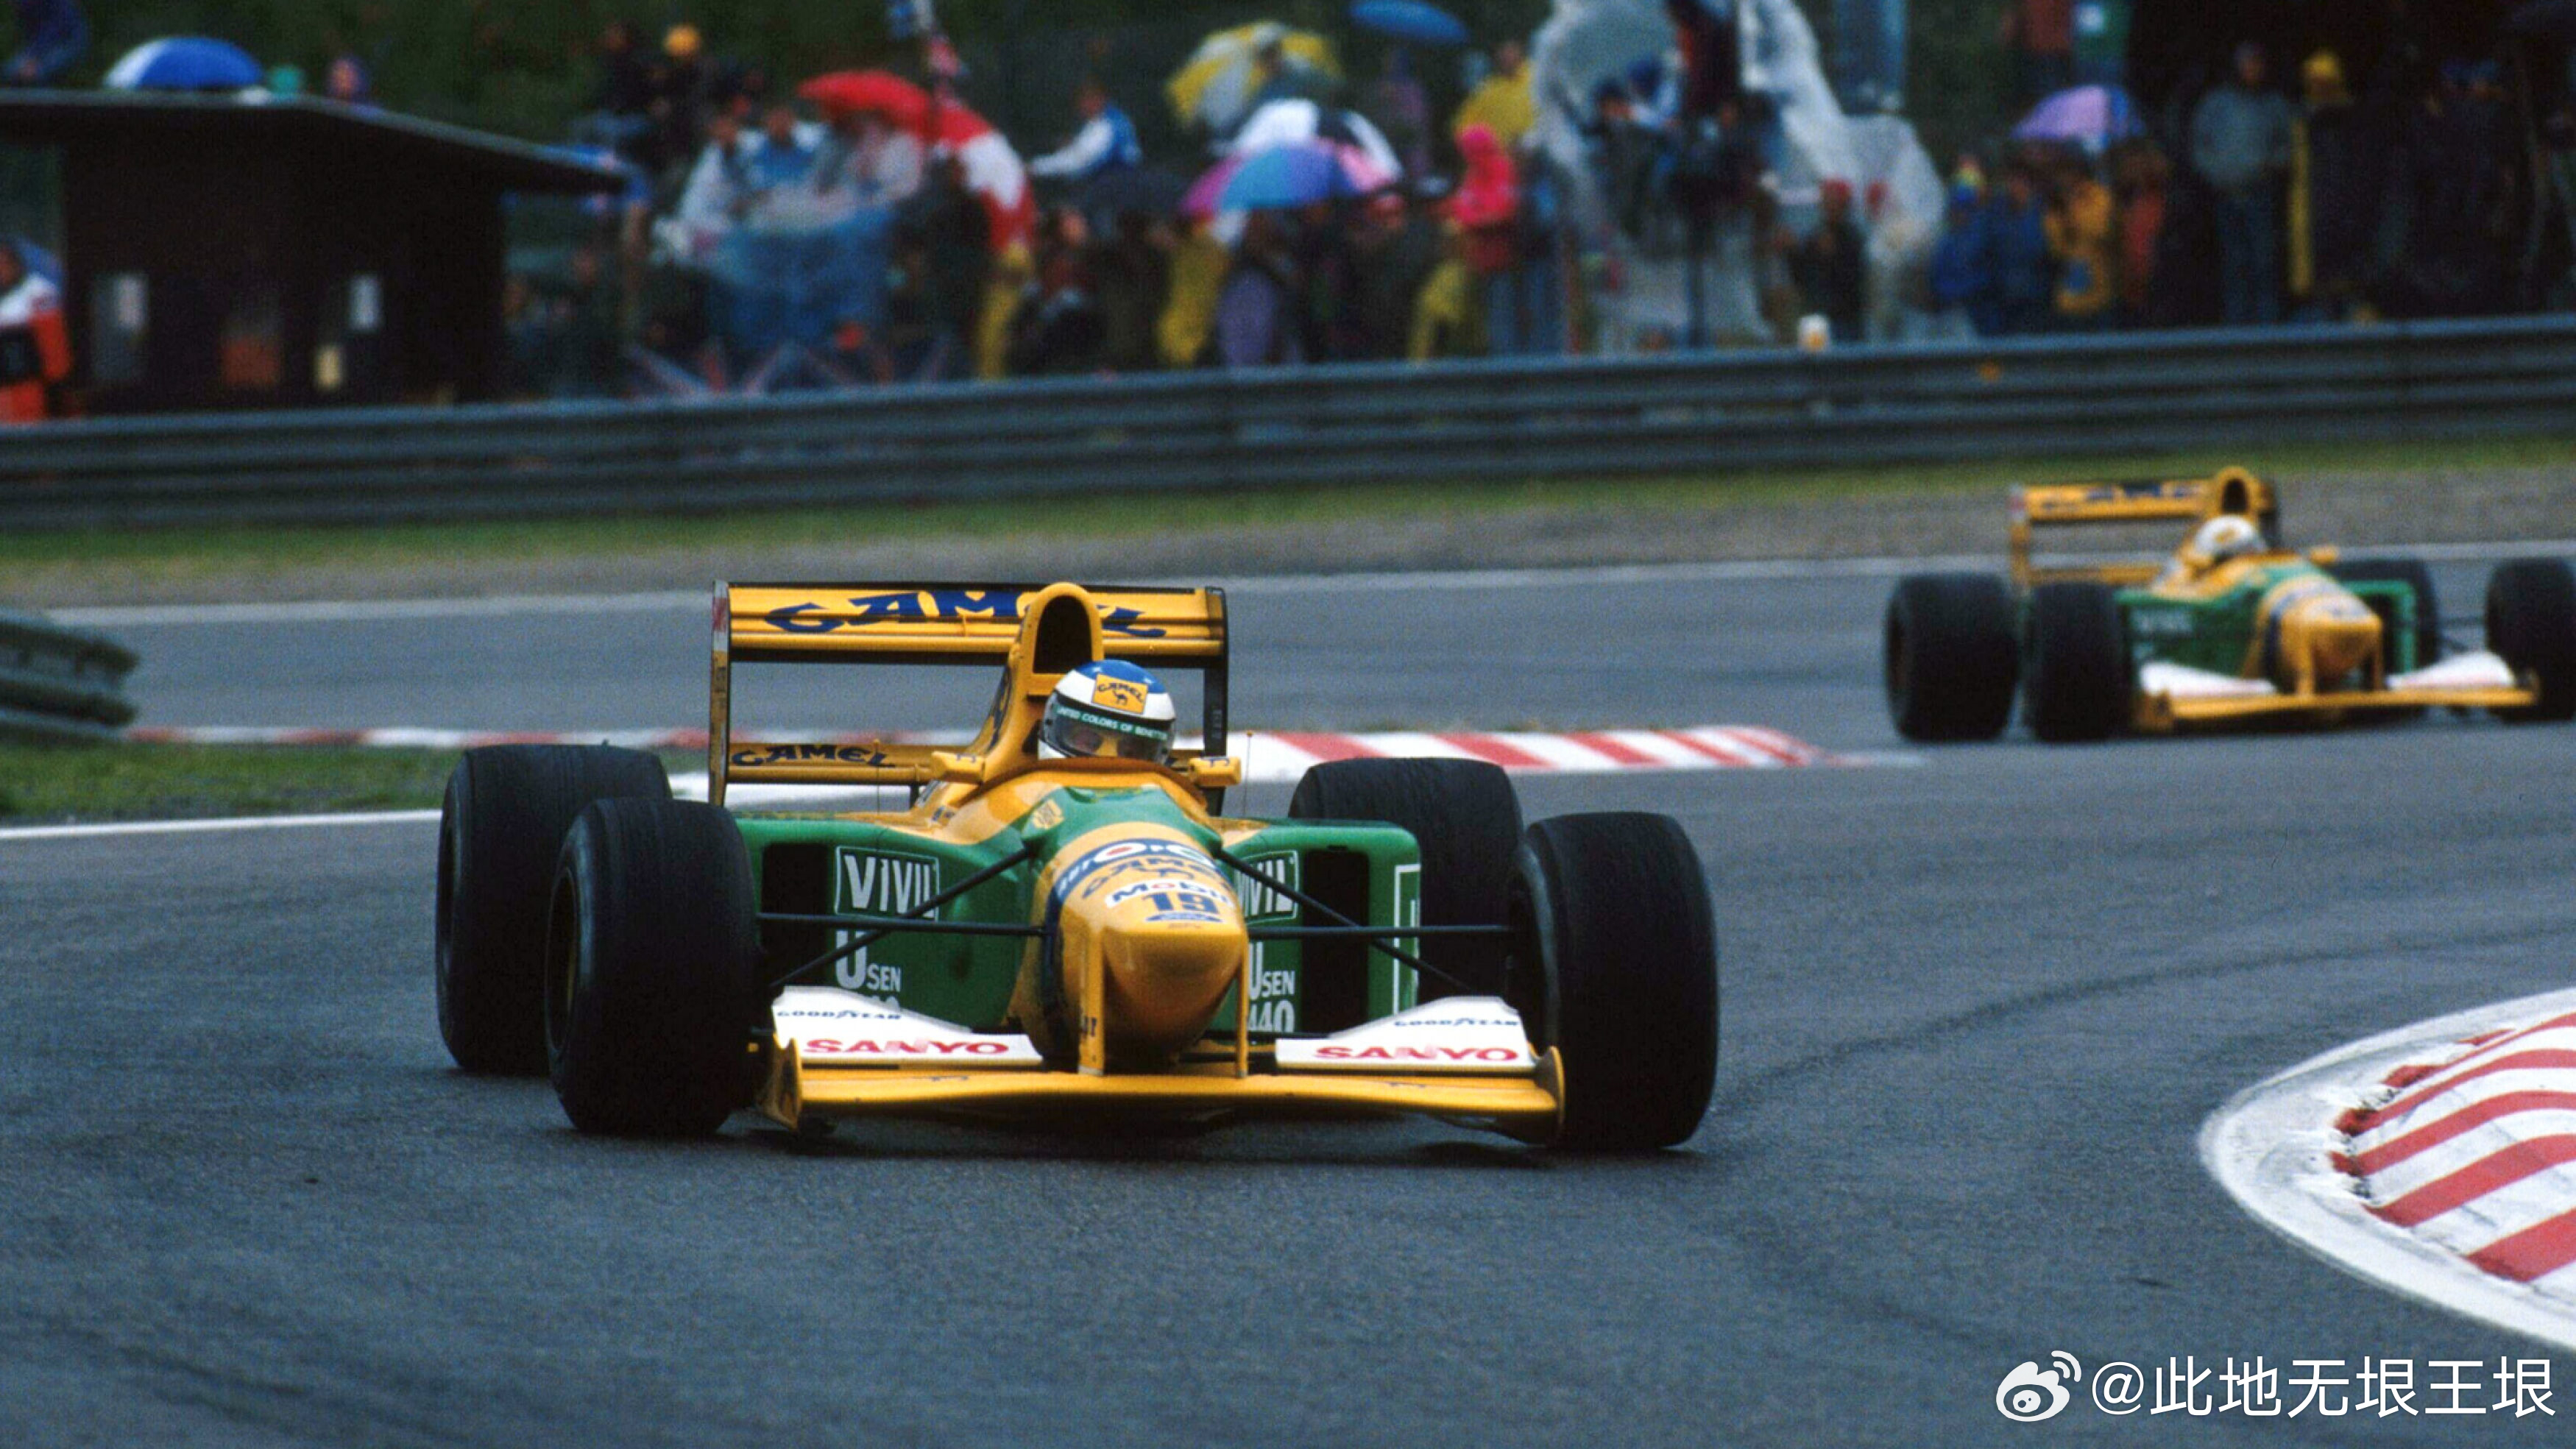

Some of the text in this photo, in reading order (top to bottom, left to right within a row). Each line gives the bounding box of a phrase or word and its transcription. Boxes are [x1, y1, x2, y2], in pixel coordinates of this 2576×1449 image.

[764, 589, 1166, 634] CAML
[1097, 682, 1145, 704] CAMEL
[732, 744, 896, 768] CAMEL
[1143, 891, 1219, 915] 19
[804, 1038, 1009, 1055] SANYO
[1315, 1046, 1519, 1061] SANYO
